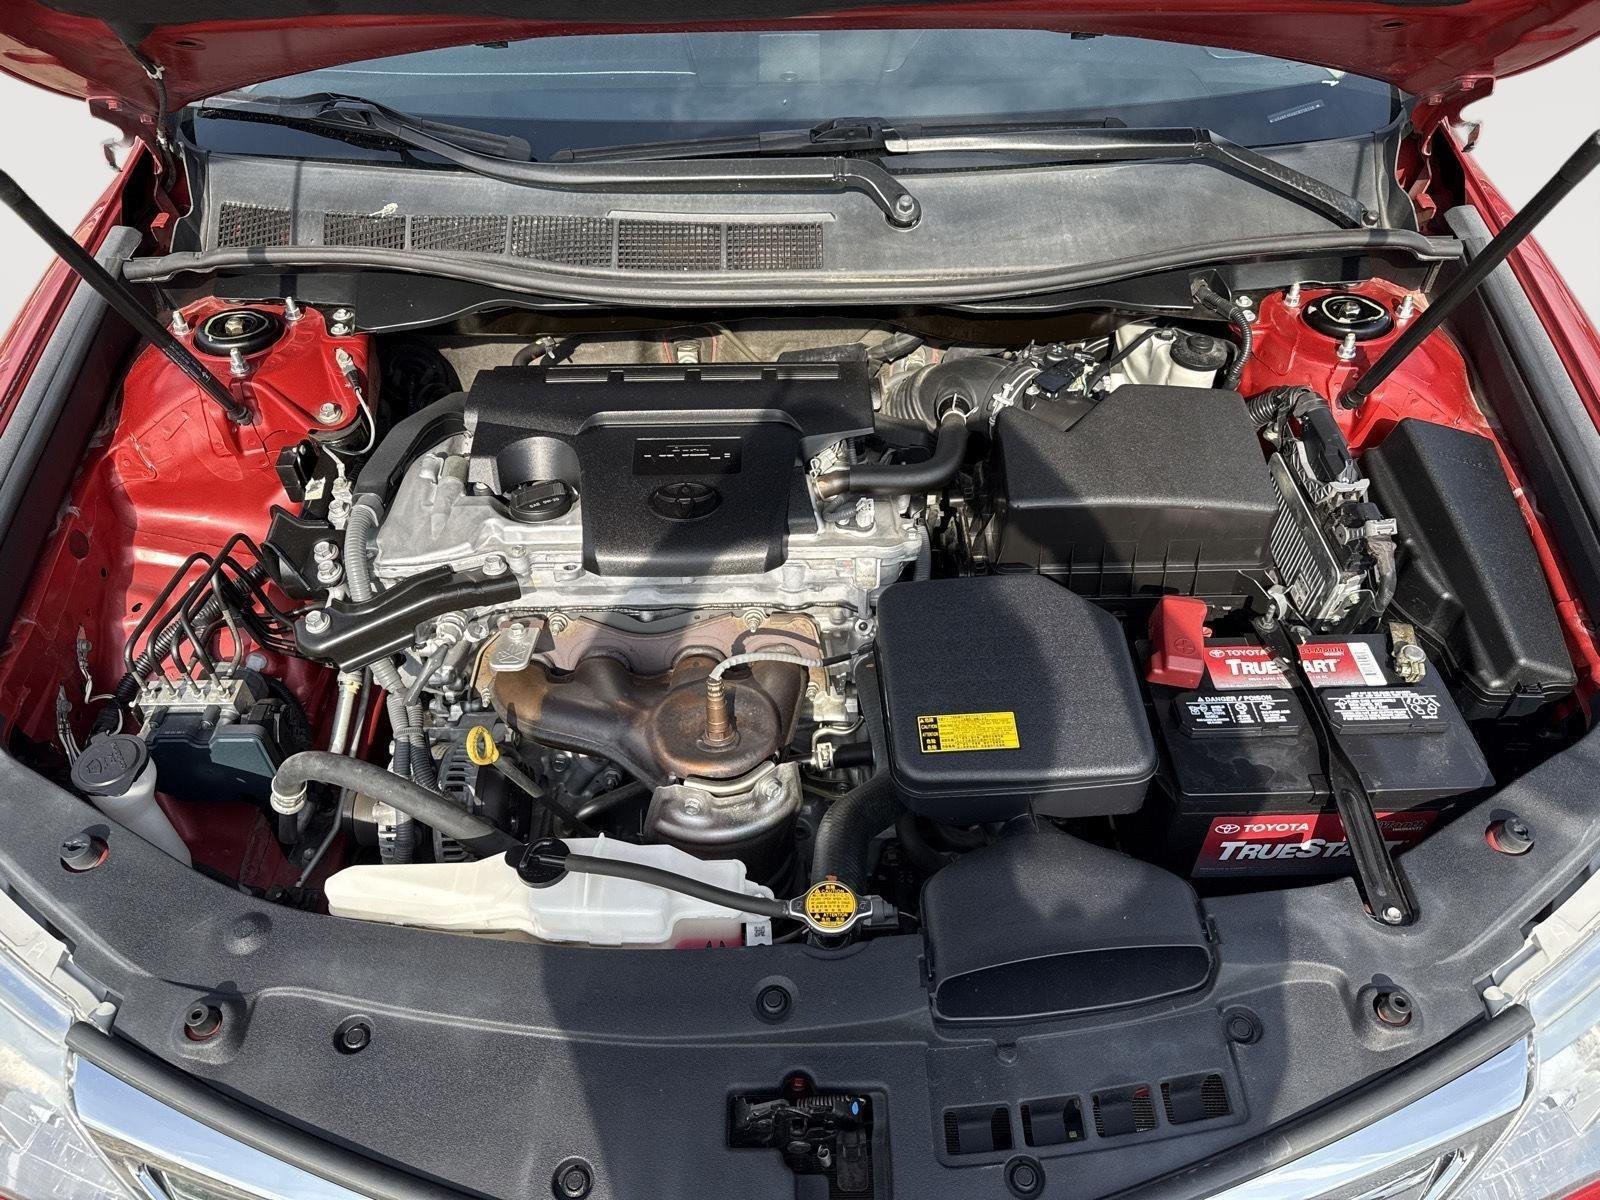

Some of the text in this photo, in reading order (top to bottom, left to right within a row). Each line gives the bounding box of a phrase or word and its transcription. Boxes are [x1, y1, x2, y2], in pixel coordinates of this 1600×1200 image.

[1225, 658, 1338, 676] TRUEART
[1243, 823, 1309, 833] TOYOTA
[1218, 840, 1402, 860] TRUESTAT
